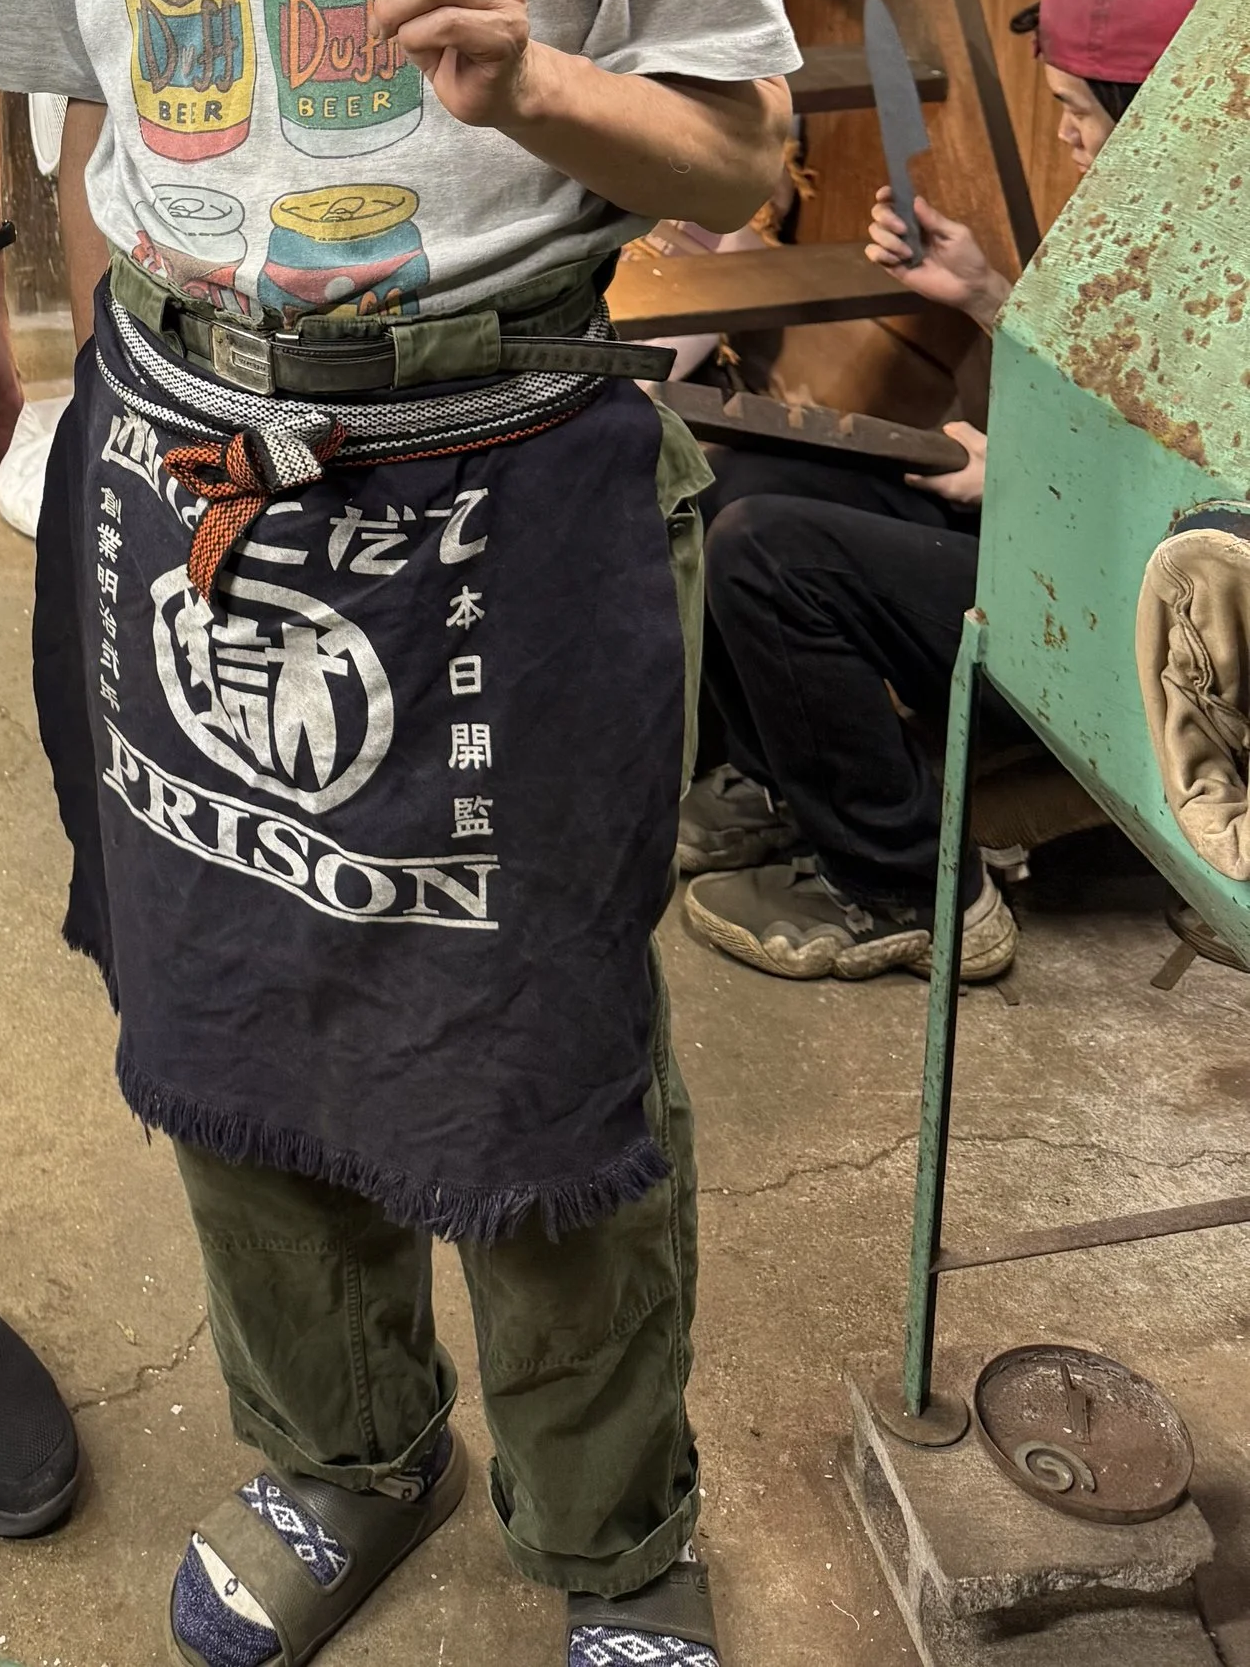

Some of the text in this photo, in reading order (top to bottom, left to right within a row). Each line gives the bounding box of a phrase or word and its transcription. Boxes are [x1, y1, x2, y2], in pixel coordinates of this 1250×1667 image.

[158, 99, 224, 125] BEER
[297, 90, 392, 119] BEER
[446, 585, 494, 838] 本日開監
[105, 724, 501, 919] PRISON
